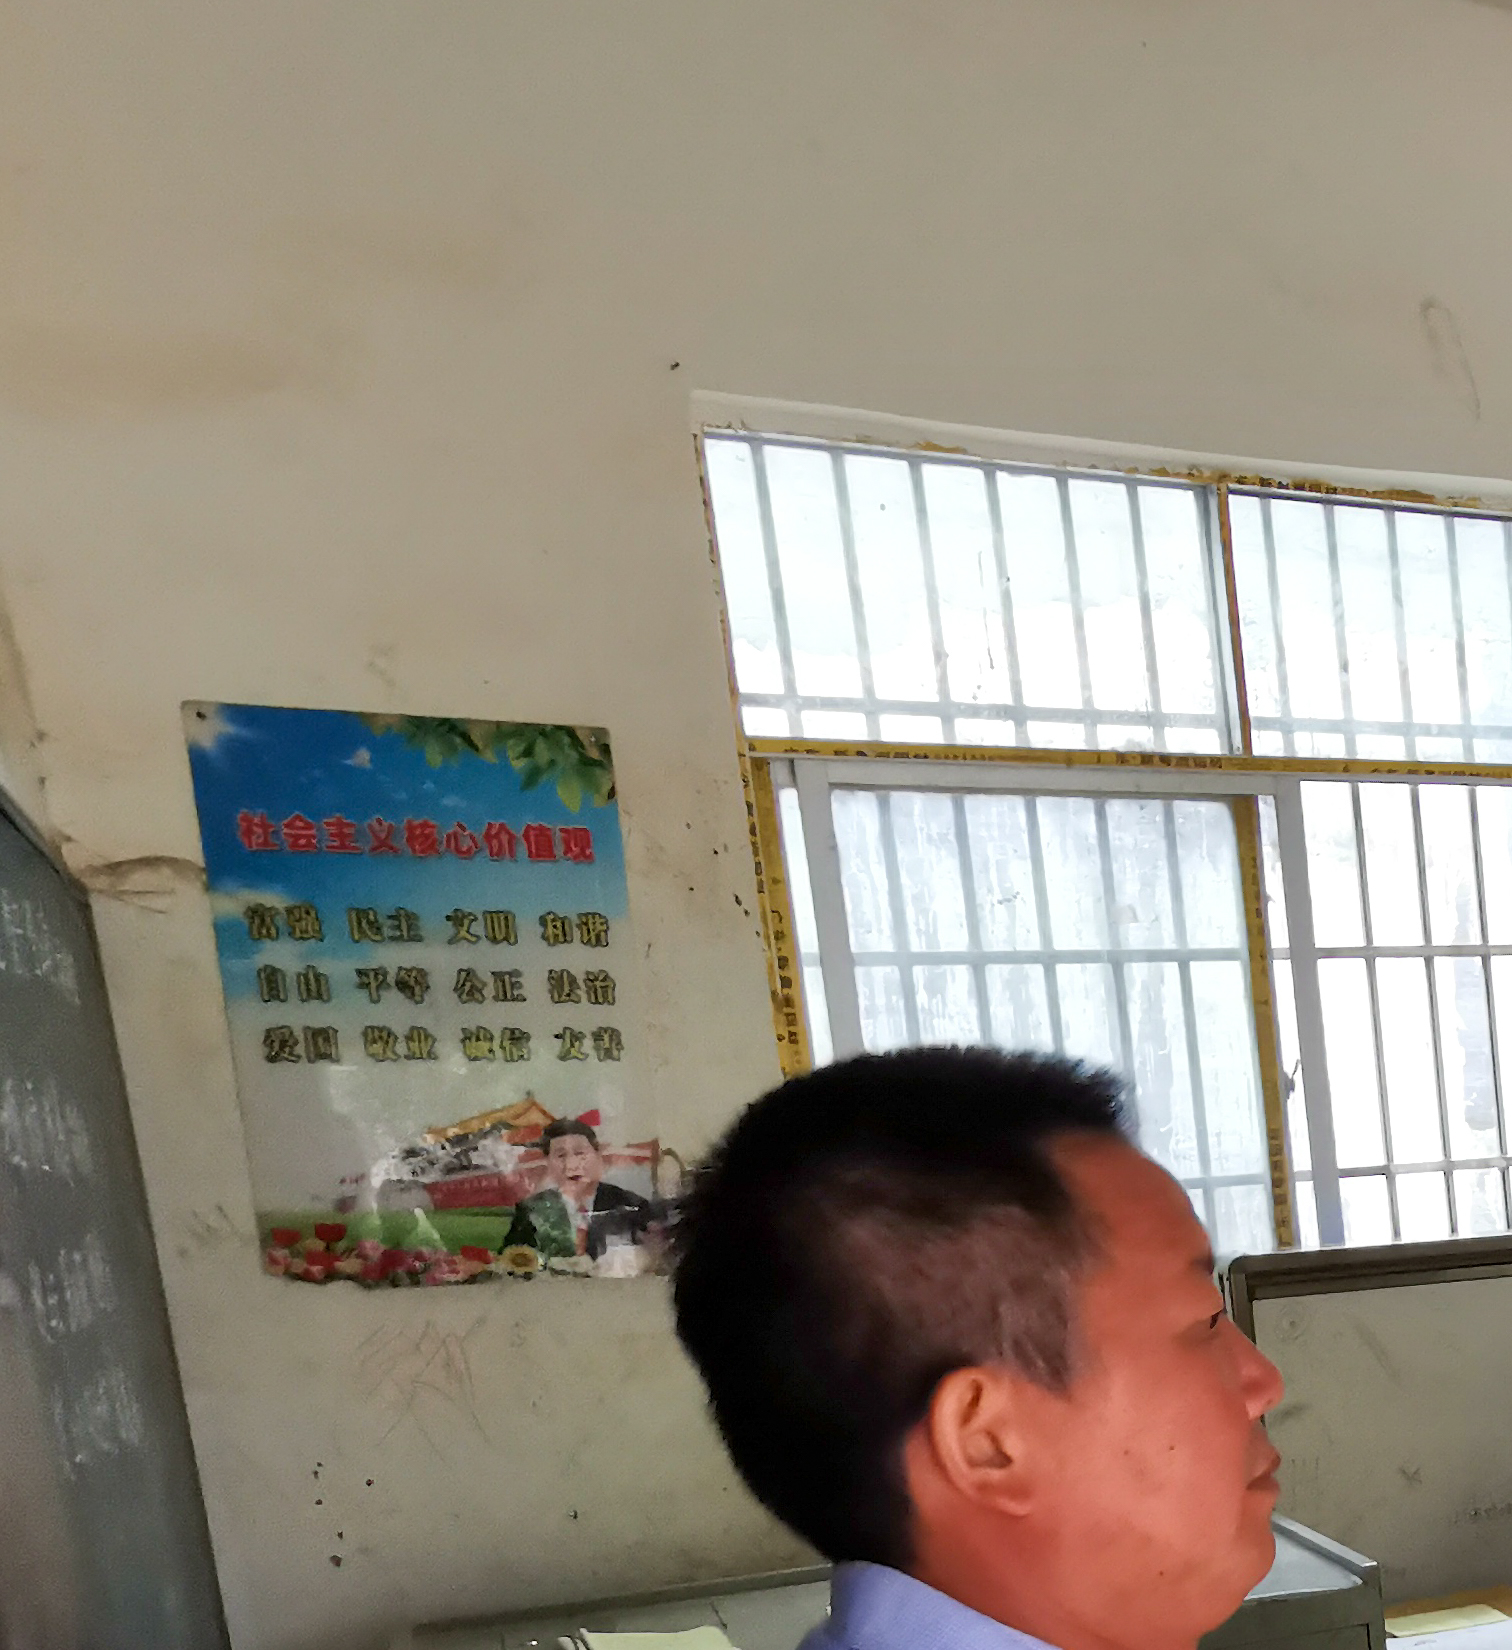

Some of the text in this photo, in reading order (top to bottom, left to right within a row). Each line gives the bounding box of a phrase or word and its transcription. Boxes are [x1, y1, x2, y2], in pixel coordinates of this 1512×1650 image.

[237, 810, 595, 863] 社会主义核心价值观
[246, 903, 610, 948] 富强 民主 文明 和谐
[257, 965, 617, 1006] 自由 平等 公正 法治
[263, 1025, 624, 1063] 爱国 敬业 诚信 友善
